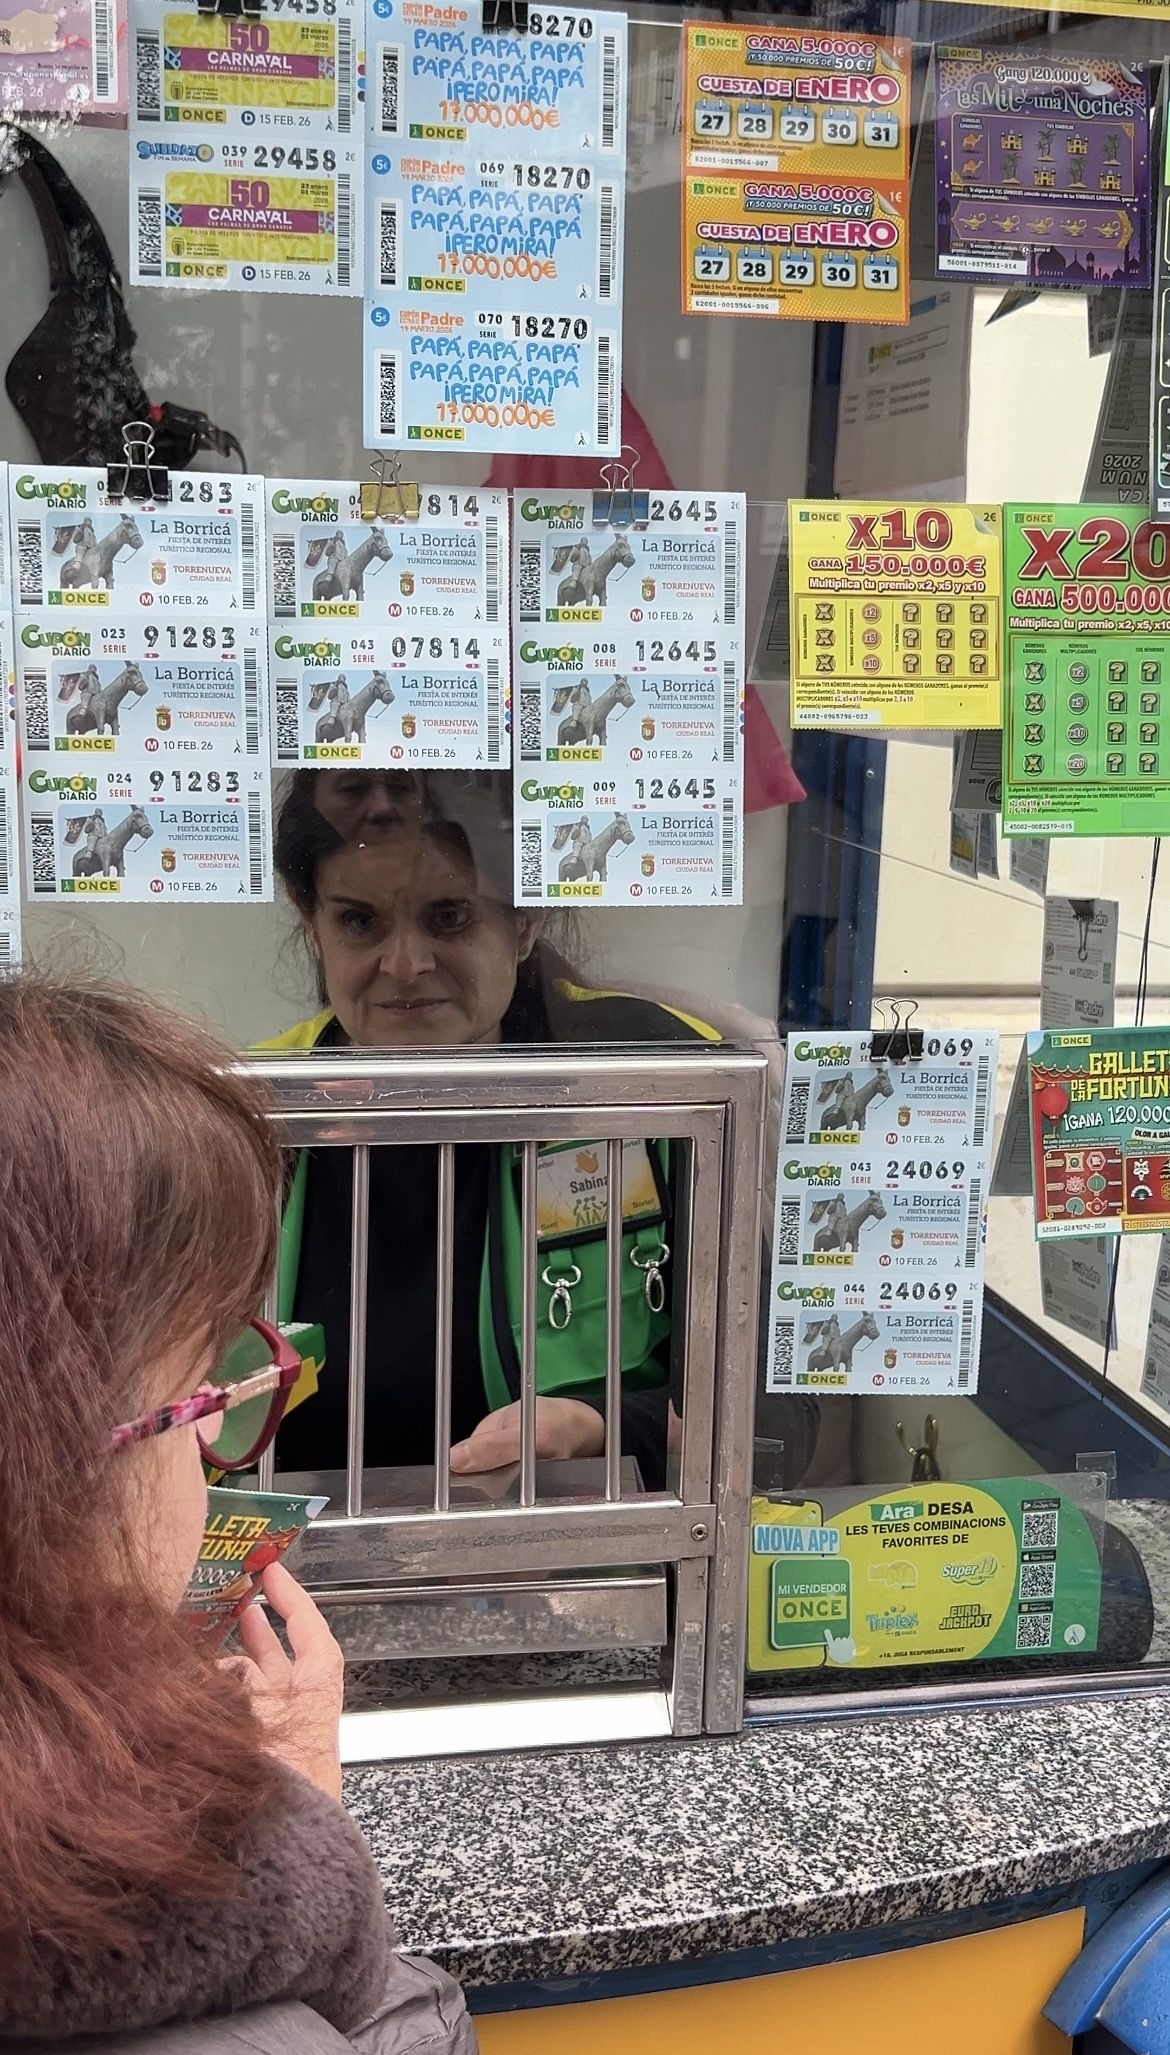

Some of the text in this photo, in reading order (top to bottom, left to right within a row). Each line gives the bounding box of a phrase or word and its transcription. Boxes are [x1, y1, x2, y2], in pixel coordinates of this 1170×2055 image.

[424, 6, 467, 21] Padre
[230, 24, 269, 51] 50
[747, 35, 876, 57] GANA 5.000€
[208, 52, 292, 69] CARNAVAL
[1131, 62, 1143, 72] 2€
[1031, 67, 1090, 84] 120.000€
[699, 74, 900, 103] CUESTA DE ENERO
[1053, 86, 1135, 119] Noches
[182, 110, 224, 122] ONCE
[260, 114, 311, 126] 15 FEB. 26
[426, 128, 464, 139] ONCE
[222, 147, 247, 157] 039
[254, 146, 336, 170] 29458
[480, 163, 504, 174] 069
[513, 165, 590, 189] 18270
[230, 181, 269, 206] 50
[707, 186, 735, 195] ONCE
[745, 184, 874, 203] GANA 5.000€
[783, 203, 817, 211] PREMIOS
[208, 208, 292, 225] CARNAVAL
[699, 221, 898, 248] CUESTA DE ENERO
[183, 266, 224, 277] ONCE
[701, 261, 889, 284] 27 28 29 30 31
[376, 312, 387, 323] 5€
[421, 312, 464, 327] Padre
[478, 314, 502, 325] 070
[512, 316, 587, 339] 18270
[411, 336, 465, 358] PAPÁ,
[468, 341, 522, 361] PAPÁ,
[424, 429, 462, 439] ONCE
[1103, 455, 1142, 469] 2026
[984, 513, 996, 522] 2€
[1027, 514, 1052, 522] ONCE
[151, 520, 231, 536] La Borricá
[847, 509, 952, 550] x10
[173, 566, 231, 574] TORRENUEVA
[809, 554, 986, 576] GANA 150.000€
[809, 578, 985, 593] Multiplica tu premio x2, x5 y x10
[66, 593, 106, 603] ONCE
[1012, 588, 1056, 607] GANA
[1010, 617, 1154, 632] Multiplica tu premio x2, x5,
[101, 629, 126, 639] 023
[144, 626, 235, 648] 91283
[351, 640, 374, 650] 043
[392, 637, 480, 659] 07814
[593, 644, 616, 653] 008
[636, 641, 717, 661] 12645
[320, 748, 358, 758] ONCE
[107, 773, 132, 783] 024
[150, 771, 240, 792] 91283
[254, 772, 263, 780] 2€
[109, 789, 132, 797] SERIE
[593, 782, 616, 792] 009
[635, 779, 715, 799] 12645
[160, 811, 238, 824] La Borricá
[641, 817, 713, 829] La Borricá
[78, 881, 117, 890] ONCE
[168, 883, 217, 891] 10 FEB. 26
[563, 886, 599, 895] ONCE
[1063, 1037, 1089, 1045] ONCE
[1089, 1050, 1170, 1075] GALLET
[1071, 1080, 1085, 1090] DE
[1071, 1091, 1085, 1102] LA
[1064, 1113, 1104, 1131] ¡GANA
[1135, 1130, 1151, 1138] OLOR
[850, 1162, 871, 1171] 043
[887, 1161, 965, 1180] 24069
[893, 1195, 961, 1207] La Borricá
[844, 1284, 865, 1293] 044
[880, 1282, 958, 1300] 24069
[903, 1352, 951, 1360] TORRENUEVA
[811, 1375, 844, 1384] ONCE
[888, 1377, 898, 1385] 10
[901, 1377, 919, 1385] FEB.
[881, 1502, 974, 1520] Ara DESA
[204, 1513, 271, 1538] LETA
[846, 1517, 1006, 1535] LES TEVES COMBINACIONS
[757, 1527, 838, 1551] NOVA APP
[882, 1534, 969, 1548] FAVORITES DE
[942, 1562, 979, 1578] Super
[778, 1584, 846, 1594] MI VENDEDOR
[783, 1600, 841, 1618] ONCE
[950, 1604, 981, 1617] EURO
[939, 1614, 991, 1630] JACKPOT
